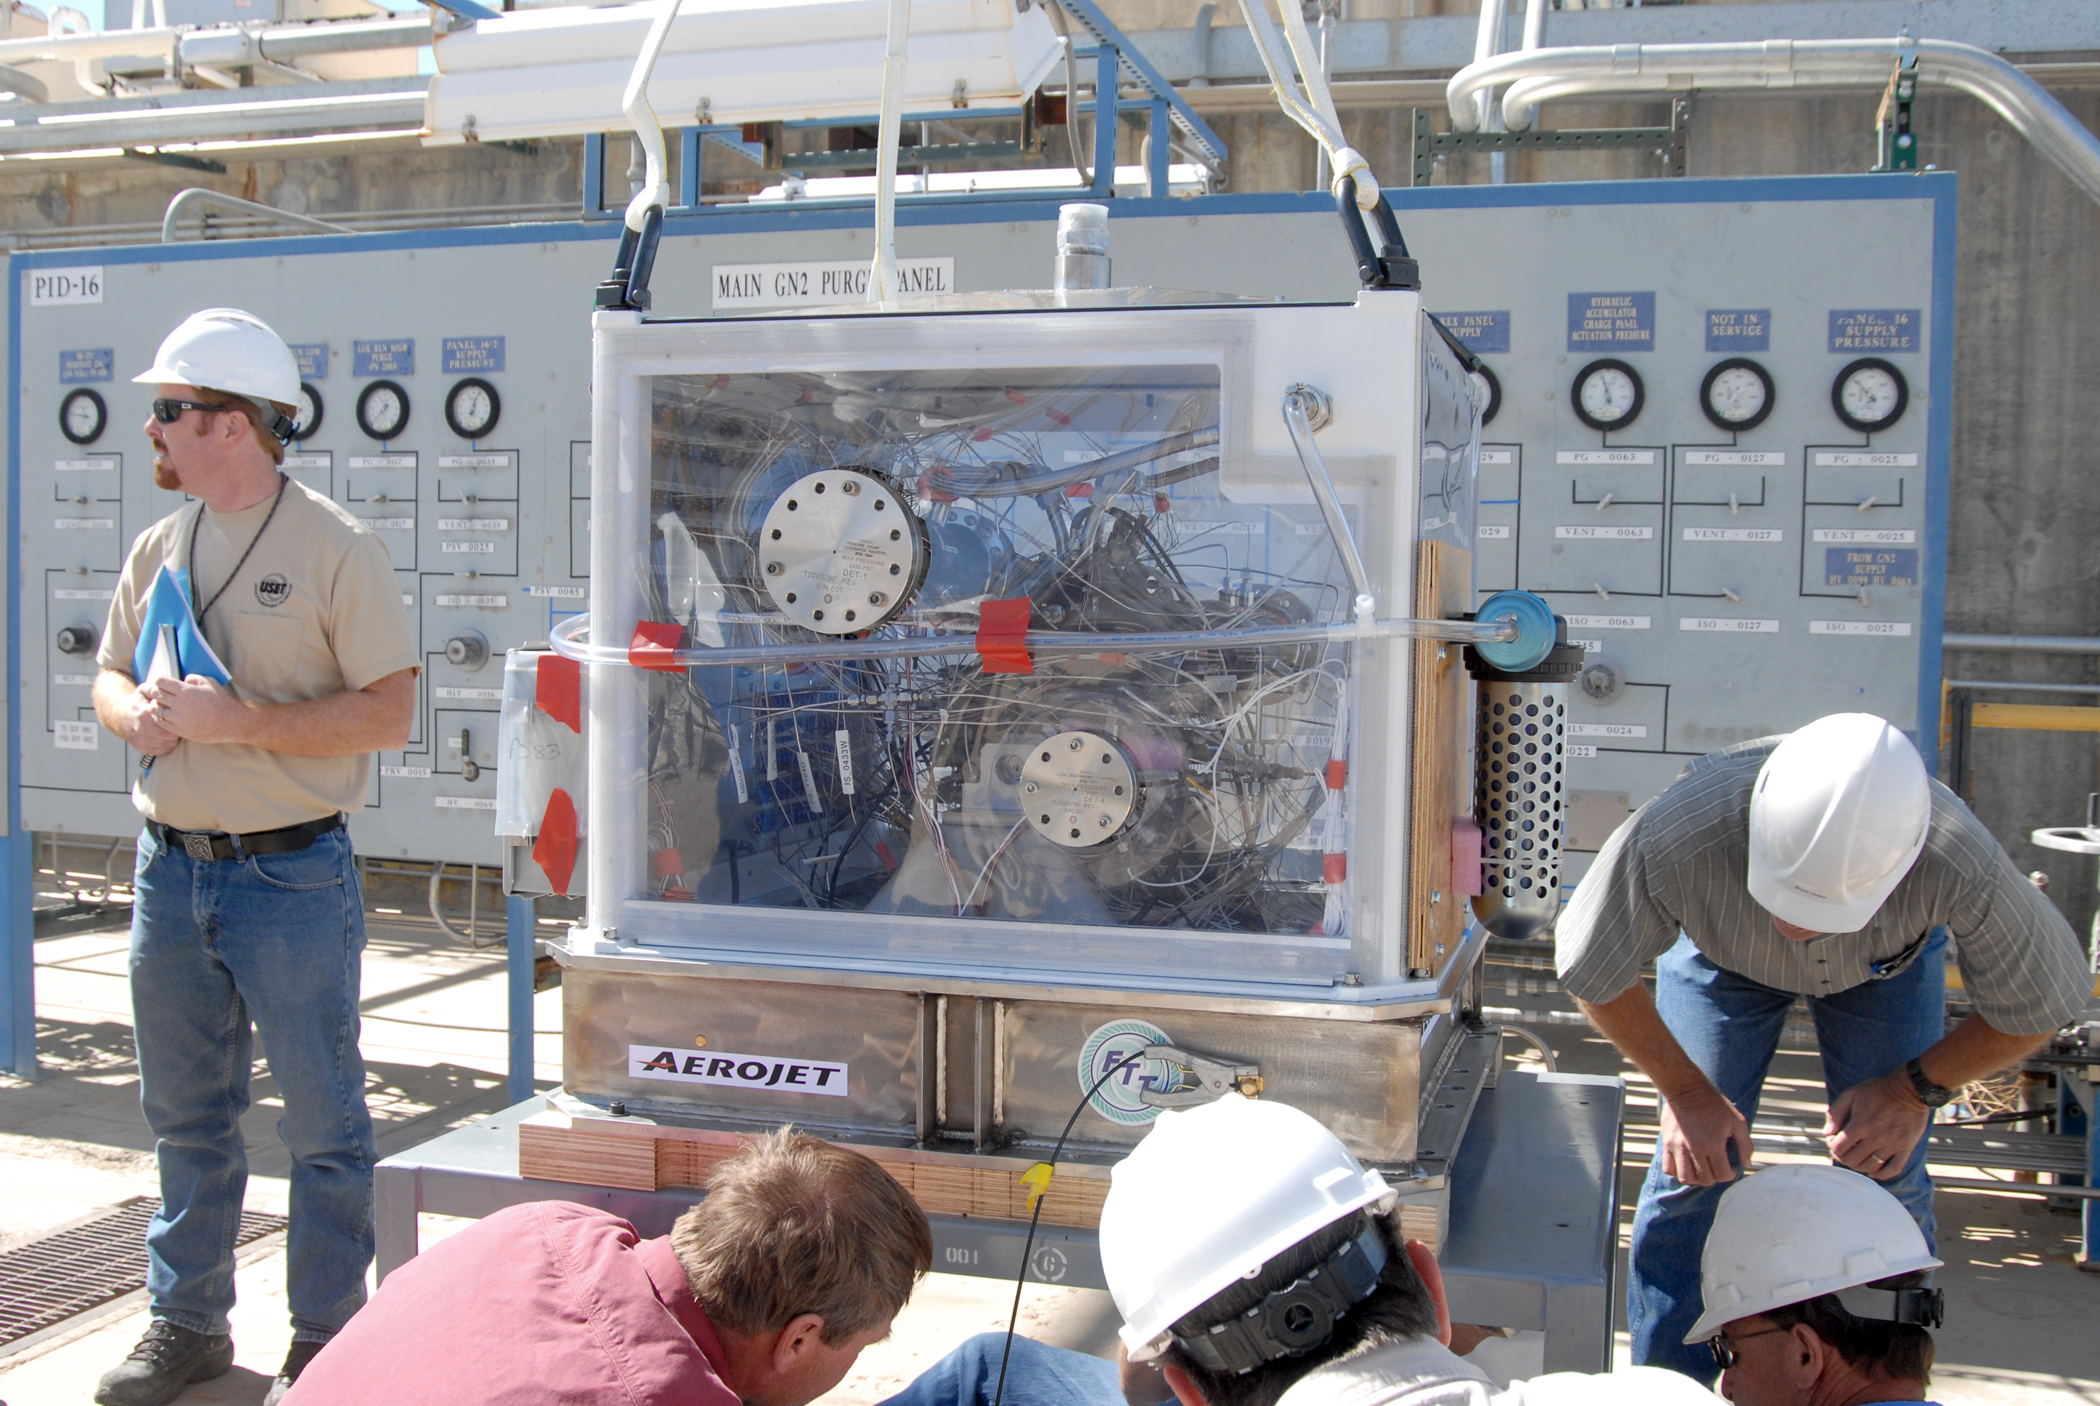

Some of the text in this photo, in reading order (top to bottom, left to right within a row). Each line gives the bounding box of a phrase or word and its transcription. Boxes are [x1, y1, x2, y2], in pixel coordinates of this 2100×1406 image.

[35, 274, 99, 298] PID-16
[718, 267, 946, 297] MAIN GN2 PURG ANEL
[1591, 297, 1632, 307] HYDRAULIC
[1586, 308, 1637, 317] ACCUMULATOR
[1464, 316, 1495, 326] PANEL
[1711, 314, 1758, 324] NOT IN
[1895, 314, 1909, 324] 16
[1584, 319, 1638, 329] CHARGE PANEL
[1449, 327, 1482, 337] SUPPLY
[1712, 325, 1763, 336] SERVICE
[1846, 326, 1898, 336] SUPPLY
[1572, 330, 1650, 341] ACTUATION PRESSURE
[446, 340, 498, 350] PANEL 16-2
[1835, 337, 1910, 348] PRESSURE
[372, 353, 393, 362] PURGE
[456, 350, 487, 359] SUPPLY
[449, 359, 494, 368] PRESSURE
[1481, 453, 1494, 461] 29
[1574, 453, 1589, 461] PG
[1609, 453, 1636, 461] 0063
[1705, 453, 1720, 462] PG
[1741, 454, 1765, 462] 0127
[1834, 455, 1849, 463] PG
[1871, 455, 1898, 463] 0025
[1481, 528, 1500, 536] 029
[1565, 528, 1595, 536] VENT
[1617, 528, 1644, 536] 0063
[1694, 530, 1726, 538] VENT
[1748, 531, 1771, 539] 0127
[1823, 531, 1856, 540] VENT
[1878, 532, 1905, 540] 0025
[446, 543, 490, 551] PSV 0025
[856, 557, 885, 566] PRESSURE
[1847, 553, 1896, 563] FROM GN2
[1855, 564, 1887, 574] SUPPLY
[843, 569, 867, 579] DET-1
[1830, 575, 1843, 584] HV
[1873, 576, 1886, 584] HV
[259, 581, 287, 594] USET
[558, 588, 580, 596] 0085
[816, 583, 843, 593] S/N 001
[1569, 617, 1588, 625] ISO
[1608, 618, 1635, 626] 0063
[1697, 620, 1717, 628] ISO
[1738, 621, 1761, 630] 0127
[1826, 623, 1845, 631] ISO
[1867, 624, 1894, 632] 0025
[477, 690, 496, 698] 0016
[1606, 726, 1632, 734] 0024
[1566, 746, 1590, 756] 022
[384, 767, 427, 776] PRV 0015
[1084, 796, 1105, 804] DET-4
[641, 1051, 841, 1086] AEROJET
[946, 1247, 978, 1265] 001
